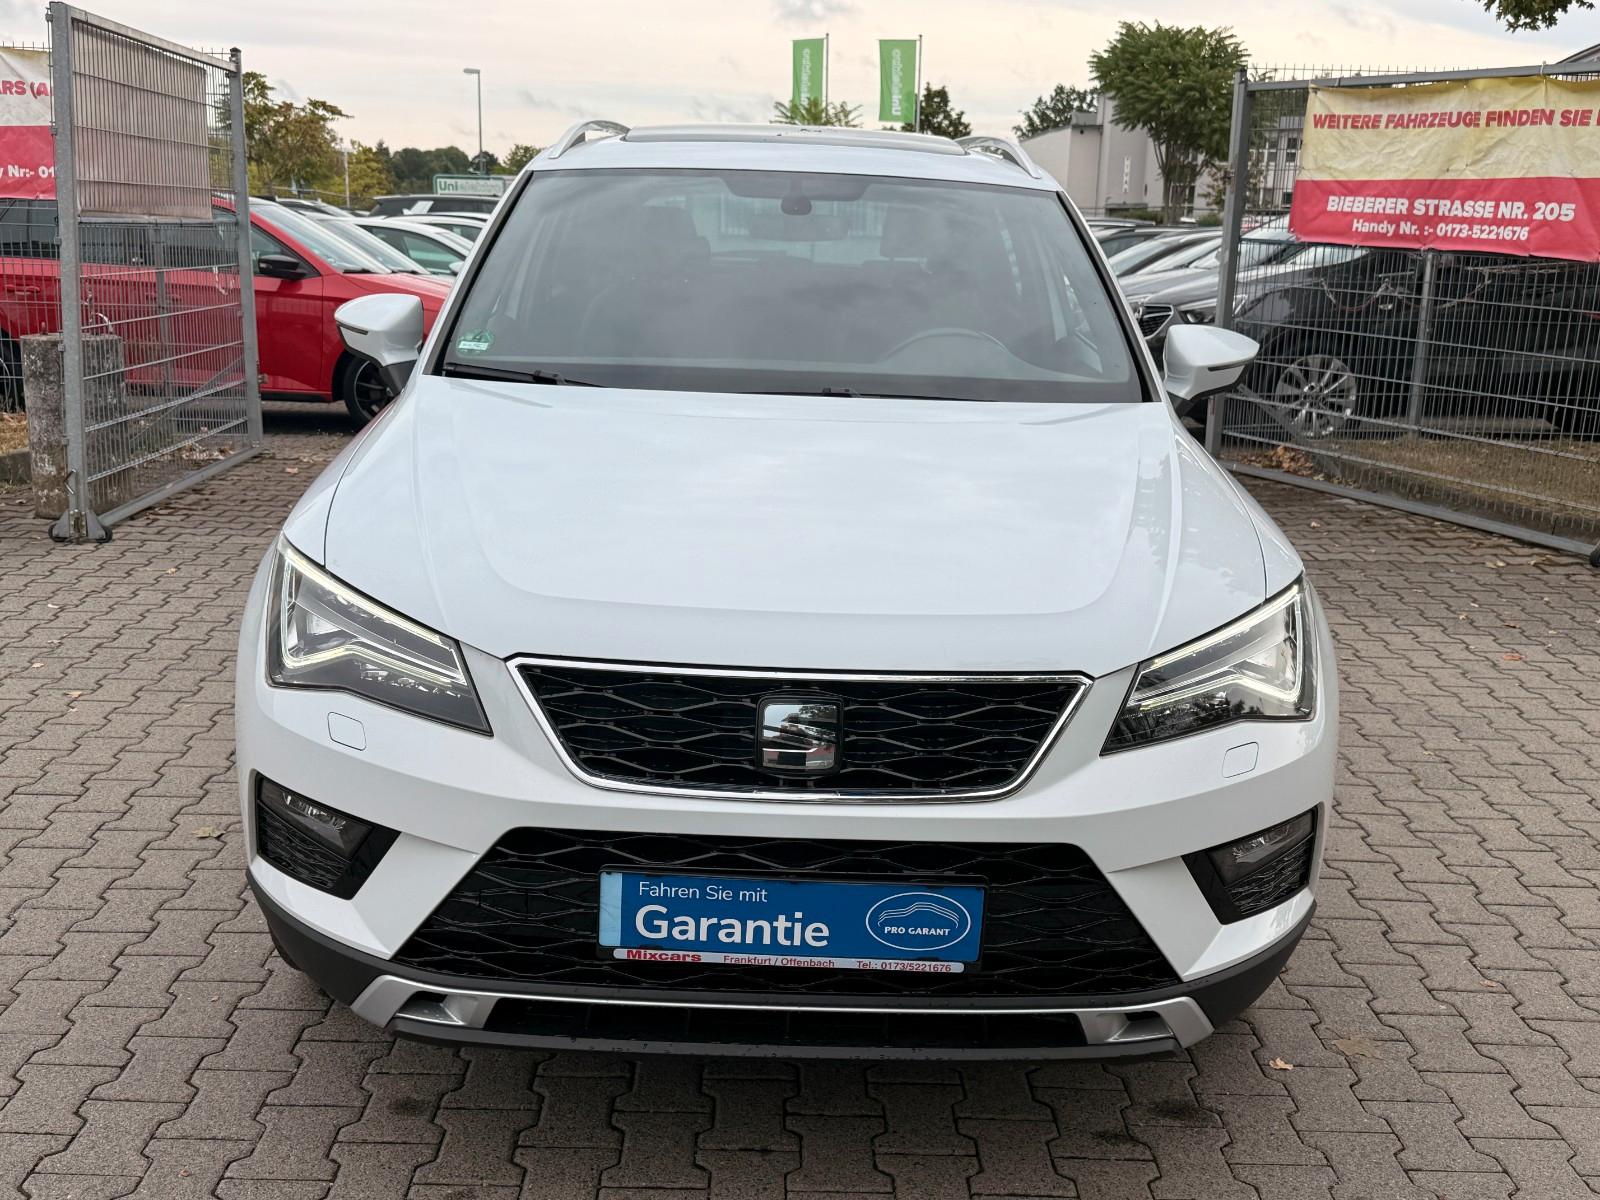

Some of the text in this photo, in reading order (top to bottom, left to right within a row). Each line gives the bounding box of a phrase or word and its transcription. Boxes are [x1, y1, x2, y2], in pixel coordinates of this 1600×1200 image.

[0, 80, 26, 96] RS
[1313, 113, 1382, 129] WEITERE
[1384, 111, 1481, 129] FAHRZEUGE
[1485, 108, 1555, 128] FINDEN
[1559, 109, 1593, 127] SIE
[1413, 198, 1495, 218] STRASSE
[1497, 201, 1528, 220] NR.
[1532, 202, 1576, 221] 205
[1352, 218, 1396, 237] Handy
[1400, 221, 1420, 236] Nr.
[1436, 222, 1530, 241] 0173-5221676
[639, 881, 769, 903] Fahren Sie mit
[635, 904, 830, 948] Garantie
[884, 926, 950, 936] PRO GARANT
[626, 949, 702, 962] Mixcars
[723, 955, 772, 966] Frankfurt
[780, 957, 835, 968] Offenbach
[856, 960, 878, 970] Tel.:
[880, 961, 952, 973] 0173/5221676
